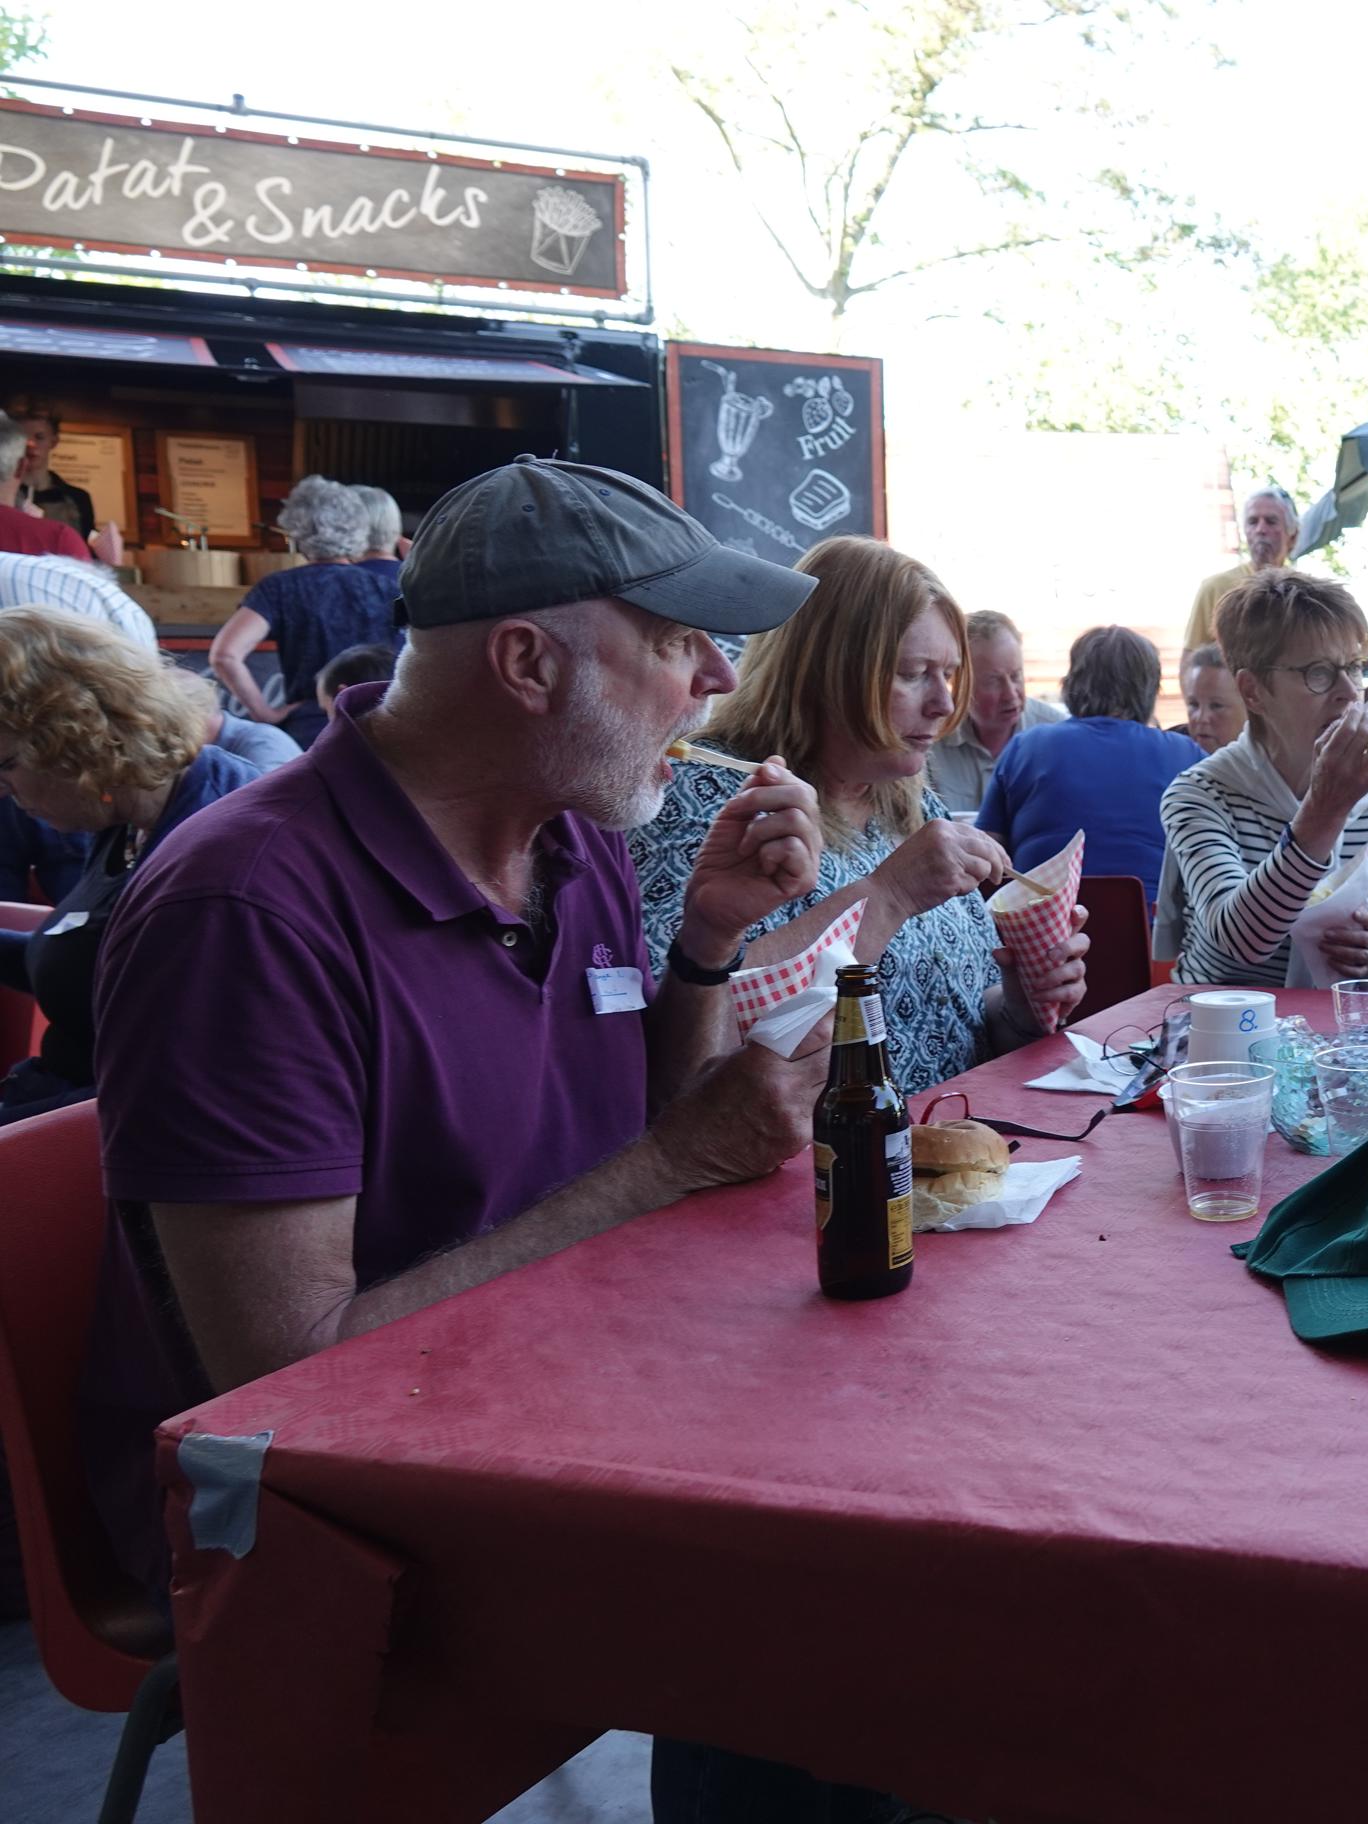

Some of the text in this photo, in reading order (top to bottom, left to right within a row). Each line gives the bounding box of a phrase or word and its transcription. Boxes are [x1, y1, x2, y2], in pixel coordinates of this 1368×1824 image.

[0, 137, 488, 246] Patat & Snacks
[797, 416, 857, 460] Fruit
